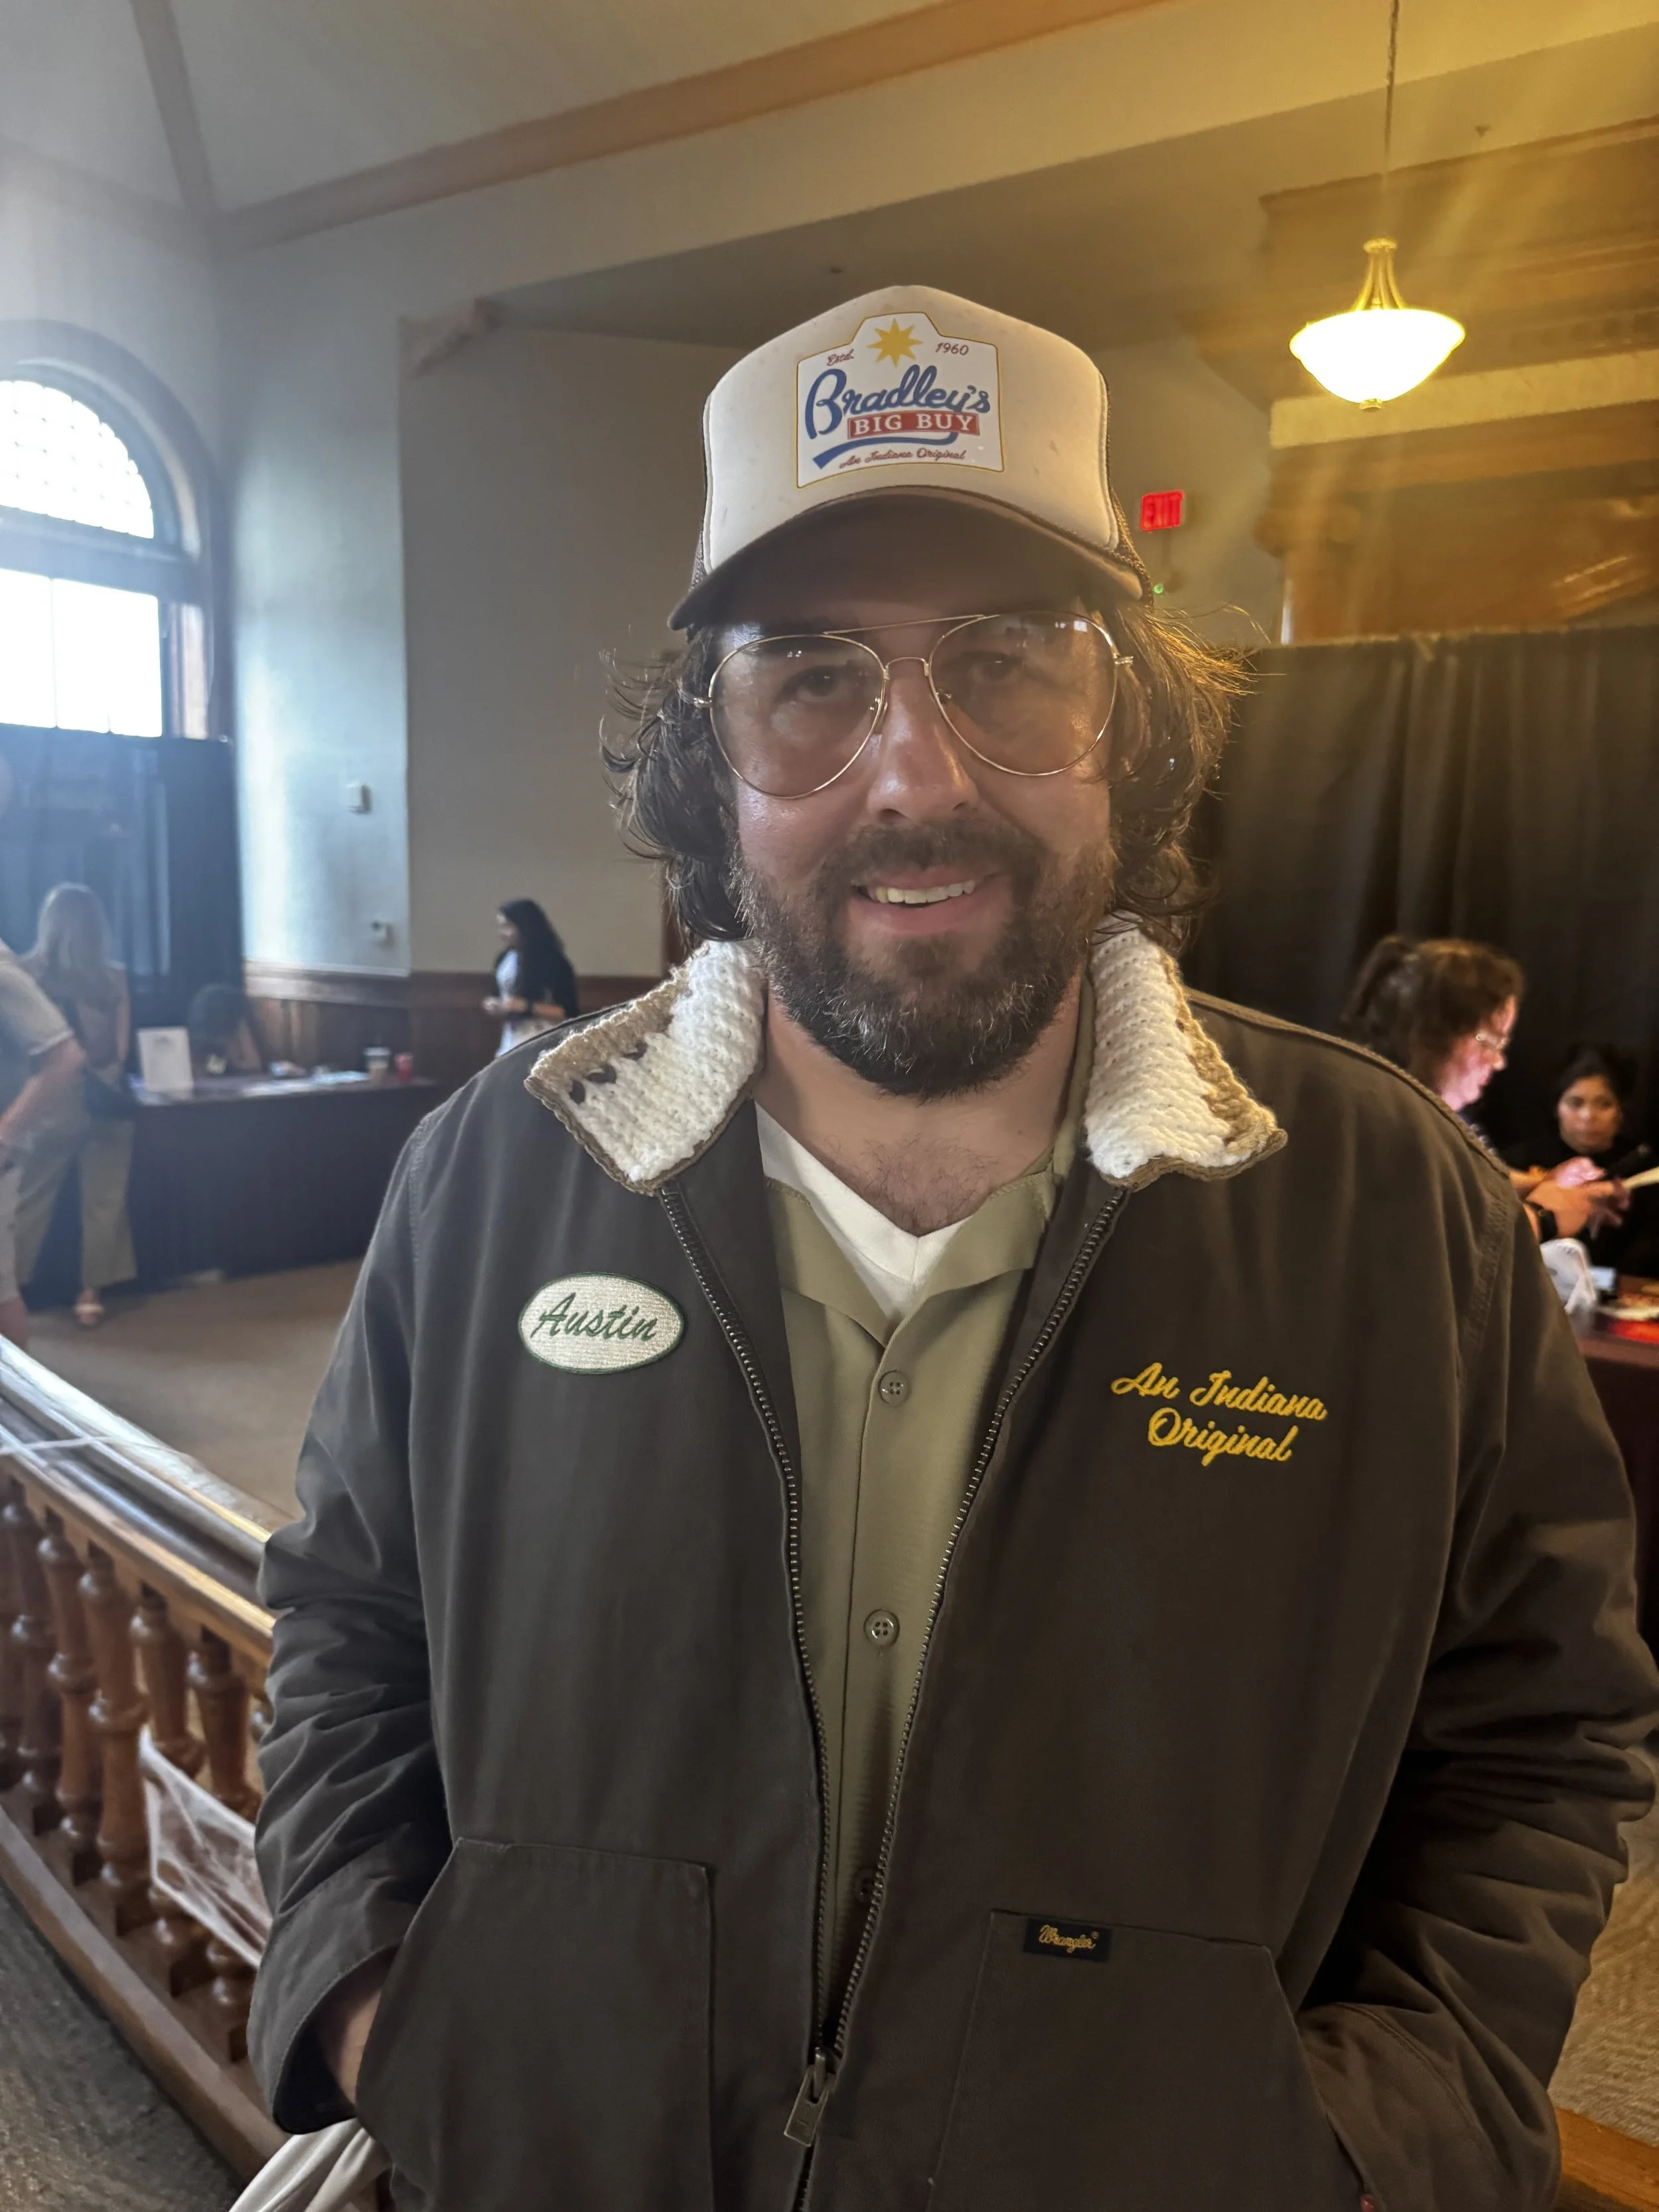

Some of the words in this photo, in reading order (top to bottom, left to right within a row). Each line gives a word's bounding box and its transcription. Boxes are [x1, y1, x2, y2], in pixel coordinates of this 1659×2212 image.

[936, 342, 970, 356] 1960
[805, 364, 991, 440] Bradley's
[853, 416, 902, 435] BIG
[916, 413, 974, 431] BUY
[839, 455, 861, 469] An
[865, 449, 914, 463] Indiana
[916, 447, 966, 461] Original
[531, 1292, 658, 1341] Austin
[1111, 1363, 1181, 1399] An
[1190, 1370, 1328, 1421] Indiana
[1148, 1407, 1299, 1467] Original
